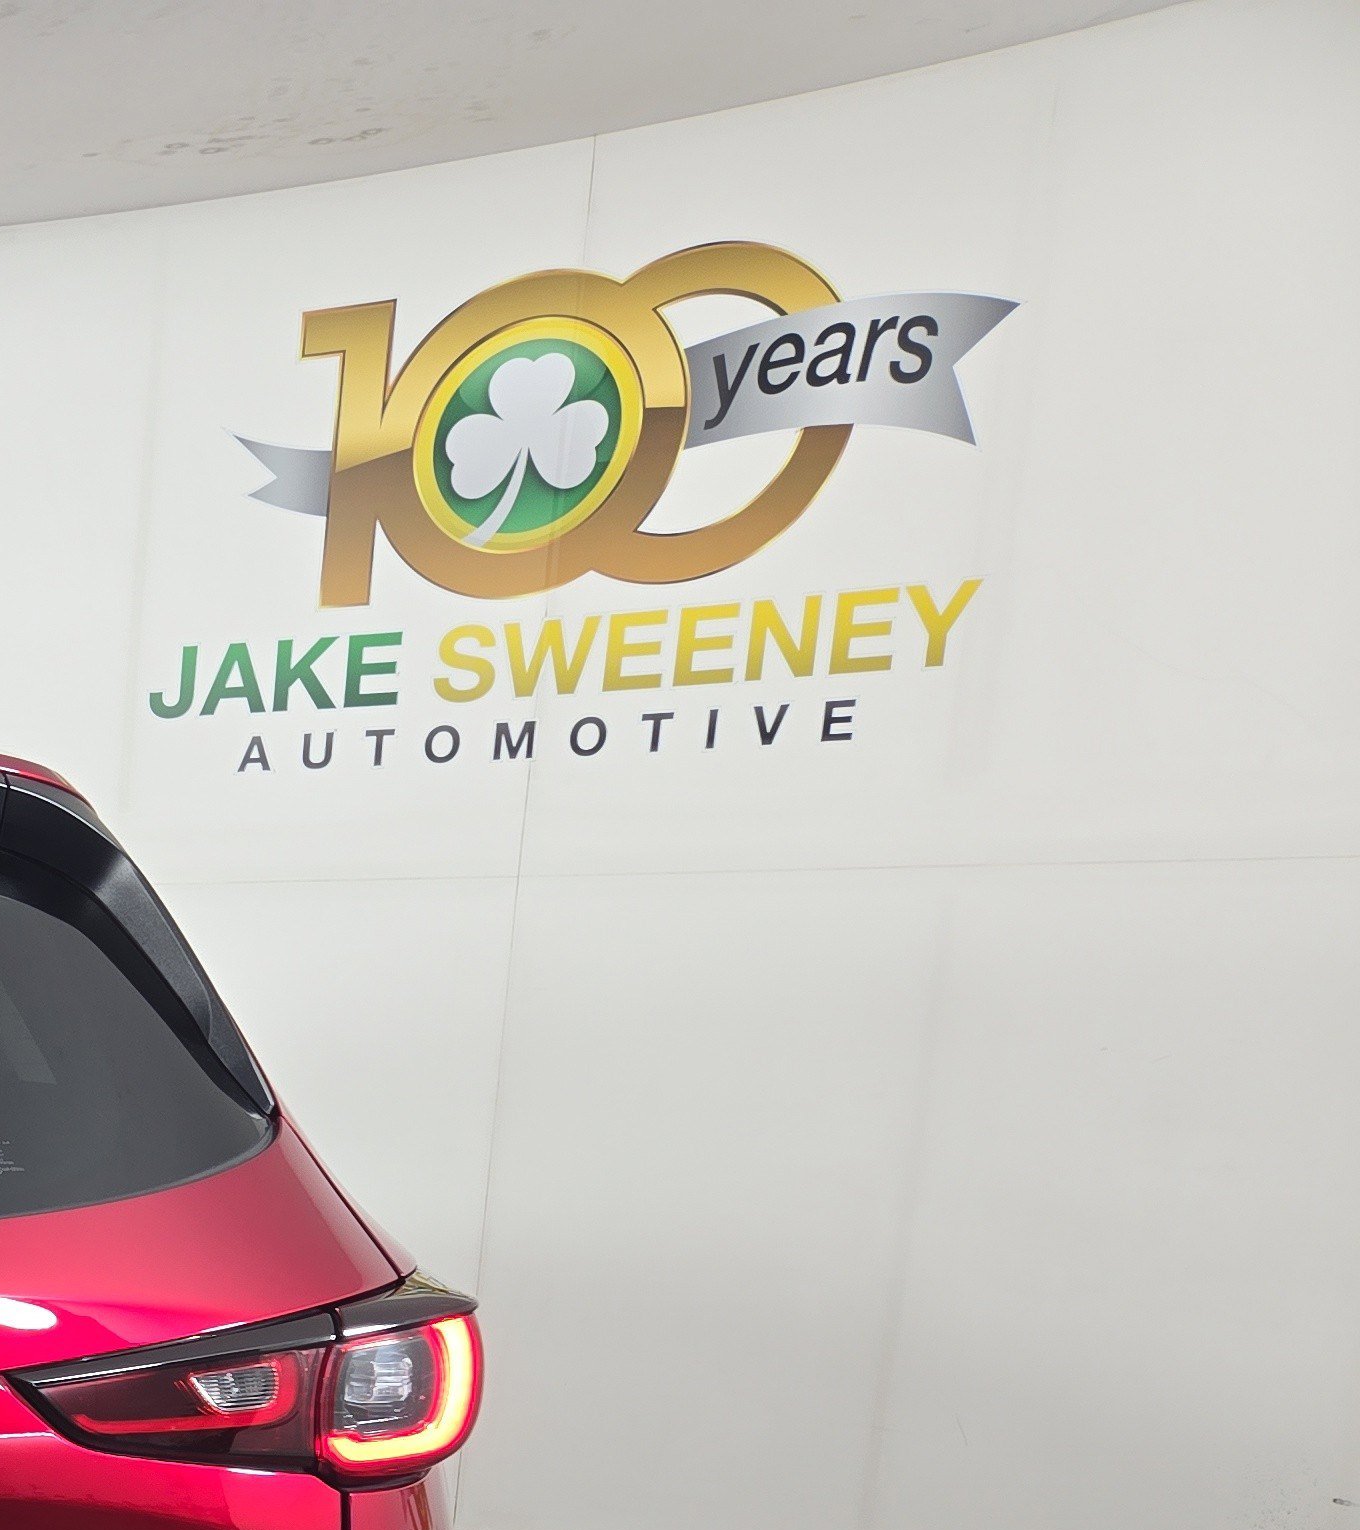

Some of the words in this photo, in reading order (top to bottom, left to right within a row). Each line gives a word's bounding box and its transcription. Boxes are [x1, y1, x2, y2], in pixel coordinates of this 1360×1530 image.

[300, 240, 854, 609] 100
[704, 313, 939, 431] years
[148, 631, 404, 720] JAKE
[433, 578, 984, 704] SWEENEY
[236, 698, 858, 774] AUTOMOTIVE
